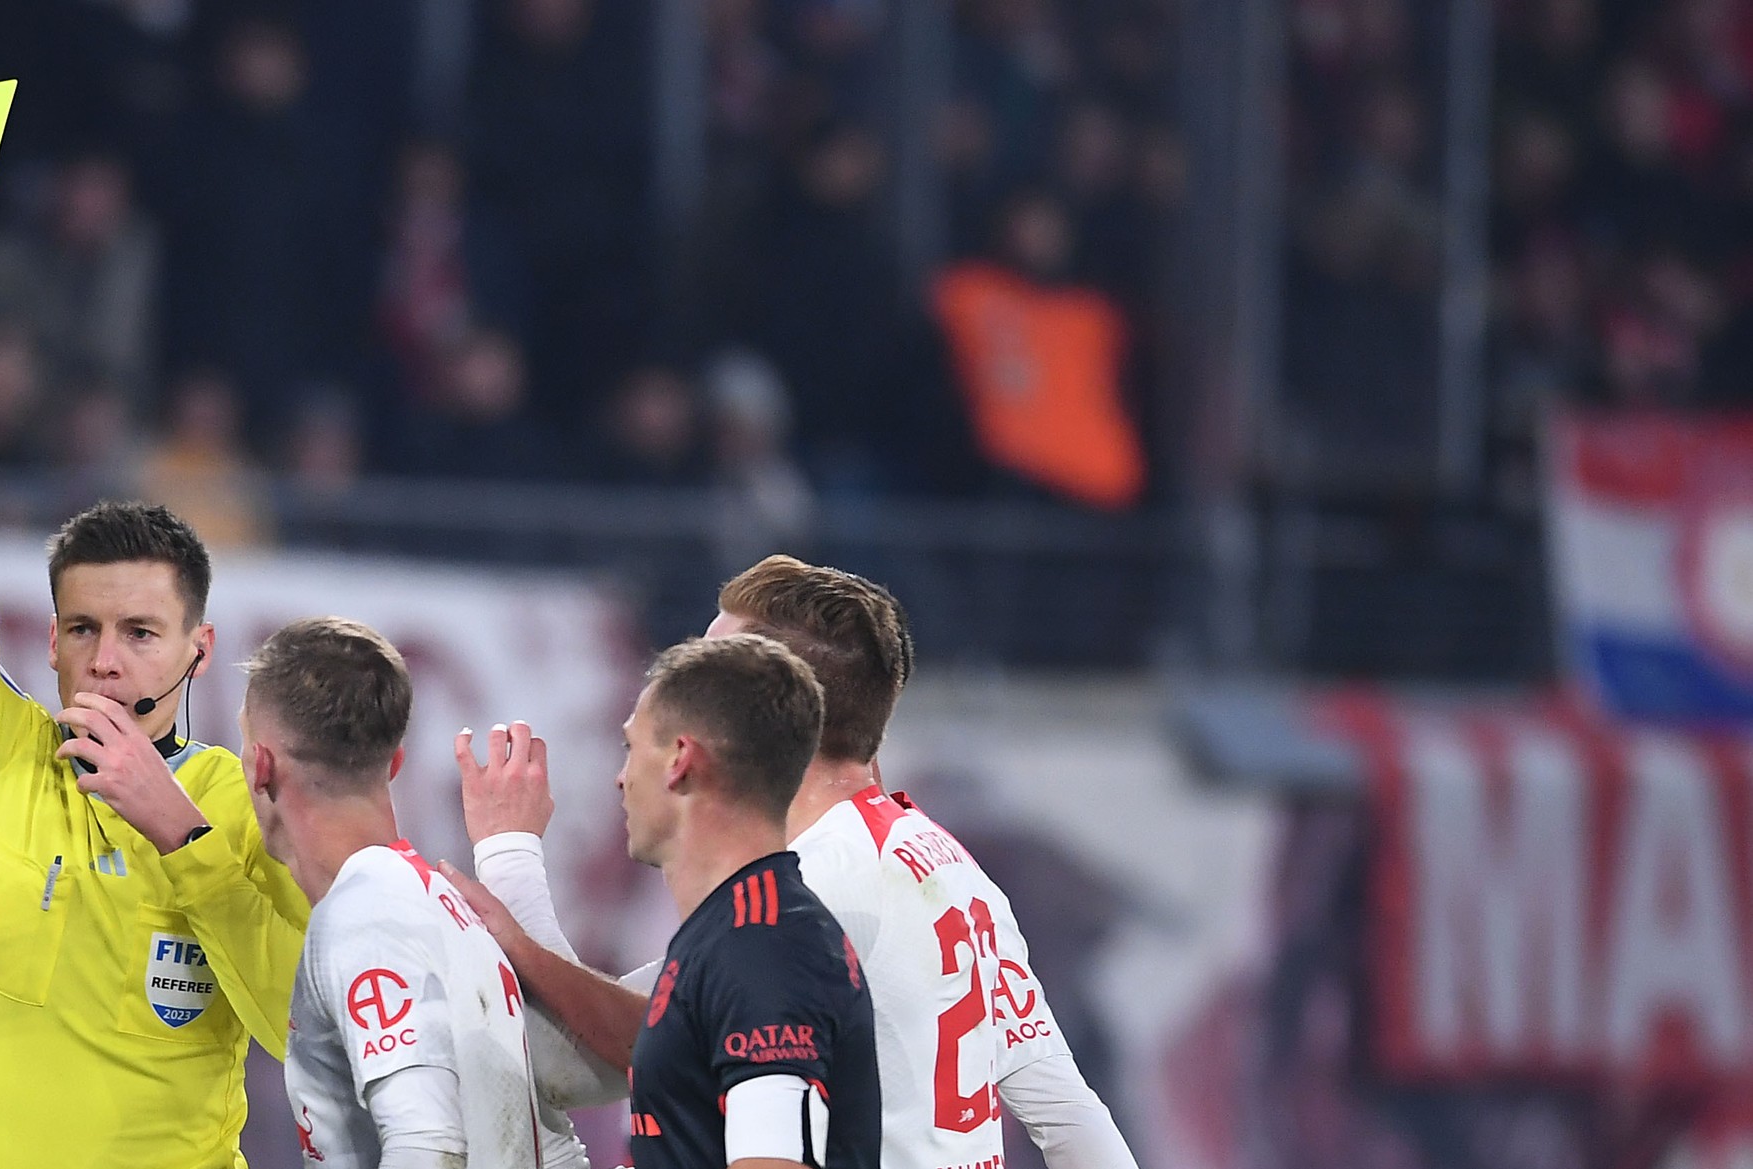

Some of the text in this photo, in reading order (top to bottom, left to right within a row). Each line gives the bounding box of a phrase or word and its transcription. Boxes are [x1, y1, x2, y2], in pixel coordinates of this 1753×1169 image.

[150, 976, 214, 994] REFEREE
[163, 1007, 192, 1022] 2023
[362, 1028, 418, 1060] AOC
[723, 1023, 816, 1058] QATAR
[1005, 1020, 1051, 1049] AOC
